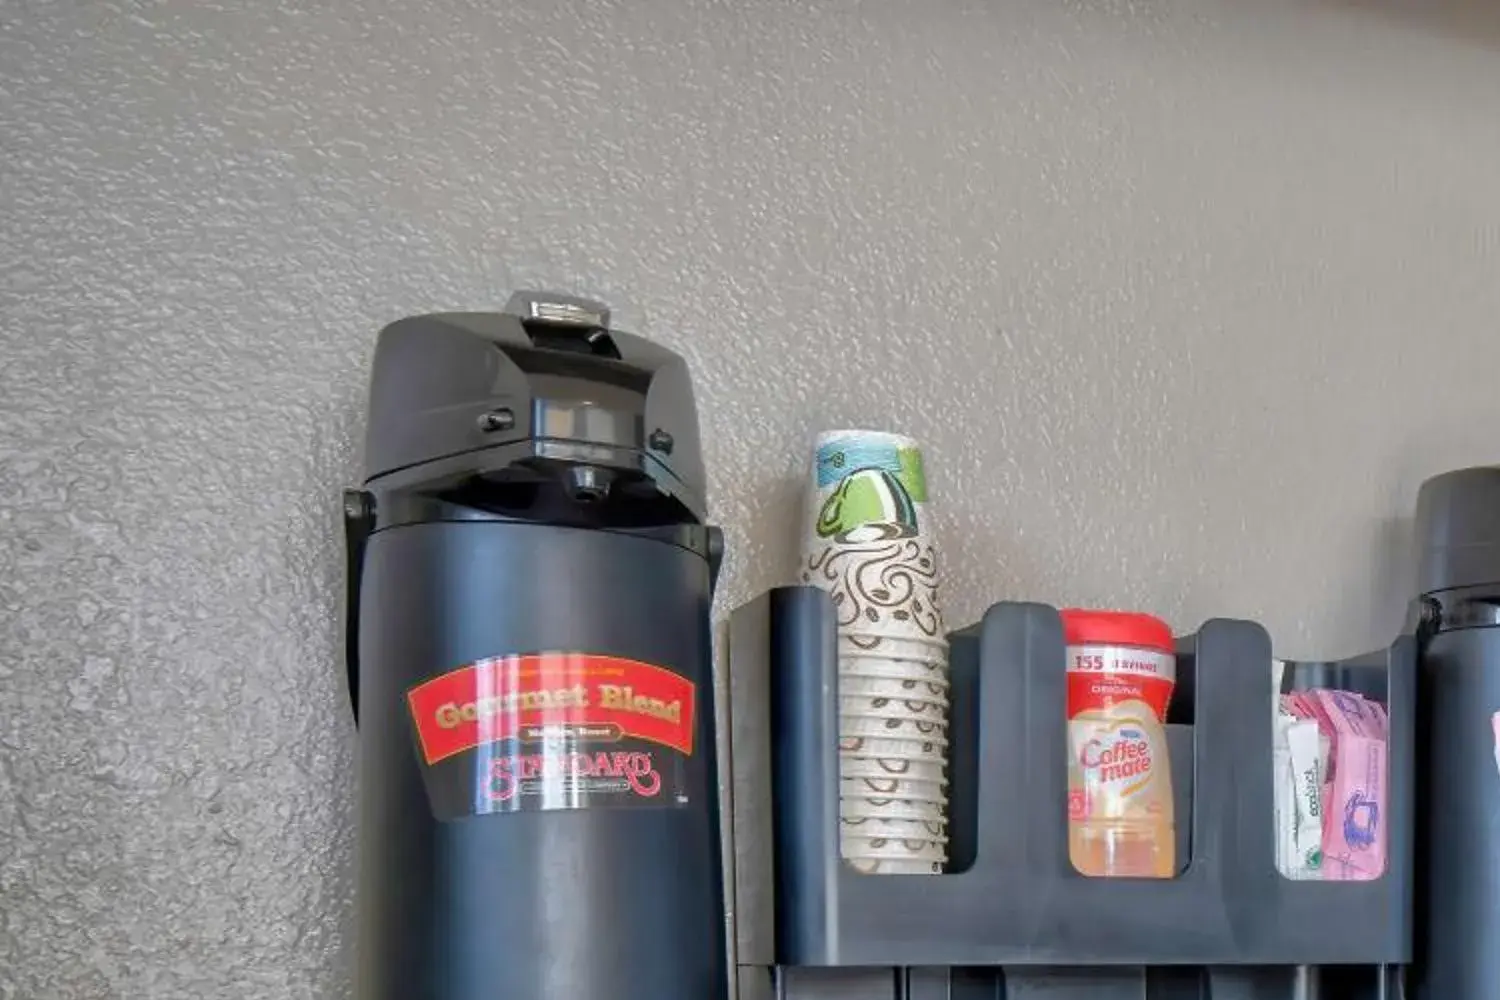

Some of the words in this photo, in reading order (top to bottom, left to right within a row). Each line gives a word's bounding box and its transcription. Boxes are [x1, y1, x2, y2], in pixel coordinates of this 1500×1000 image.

[1075, 655, 1104, 670] 155
[435, 683, 590, 729] Gourmet
[599, 684, 681, 725] Blend
[1082, 739, 1148, 768] Coffee
[486, 751, 661, 802] STADARD
[1101, 757, 1152, 783] mate
